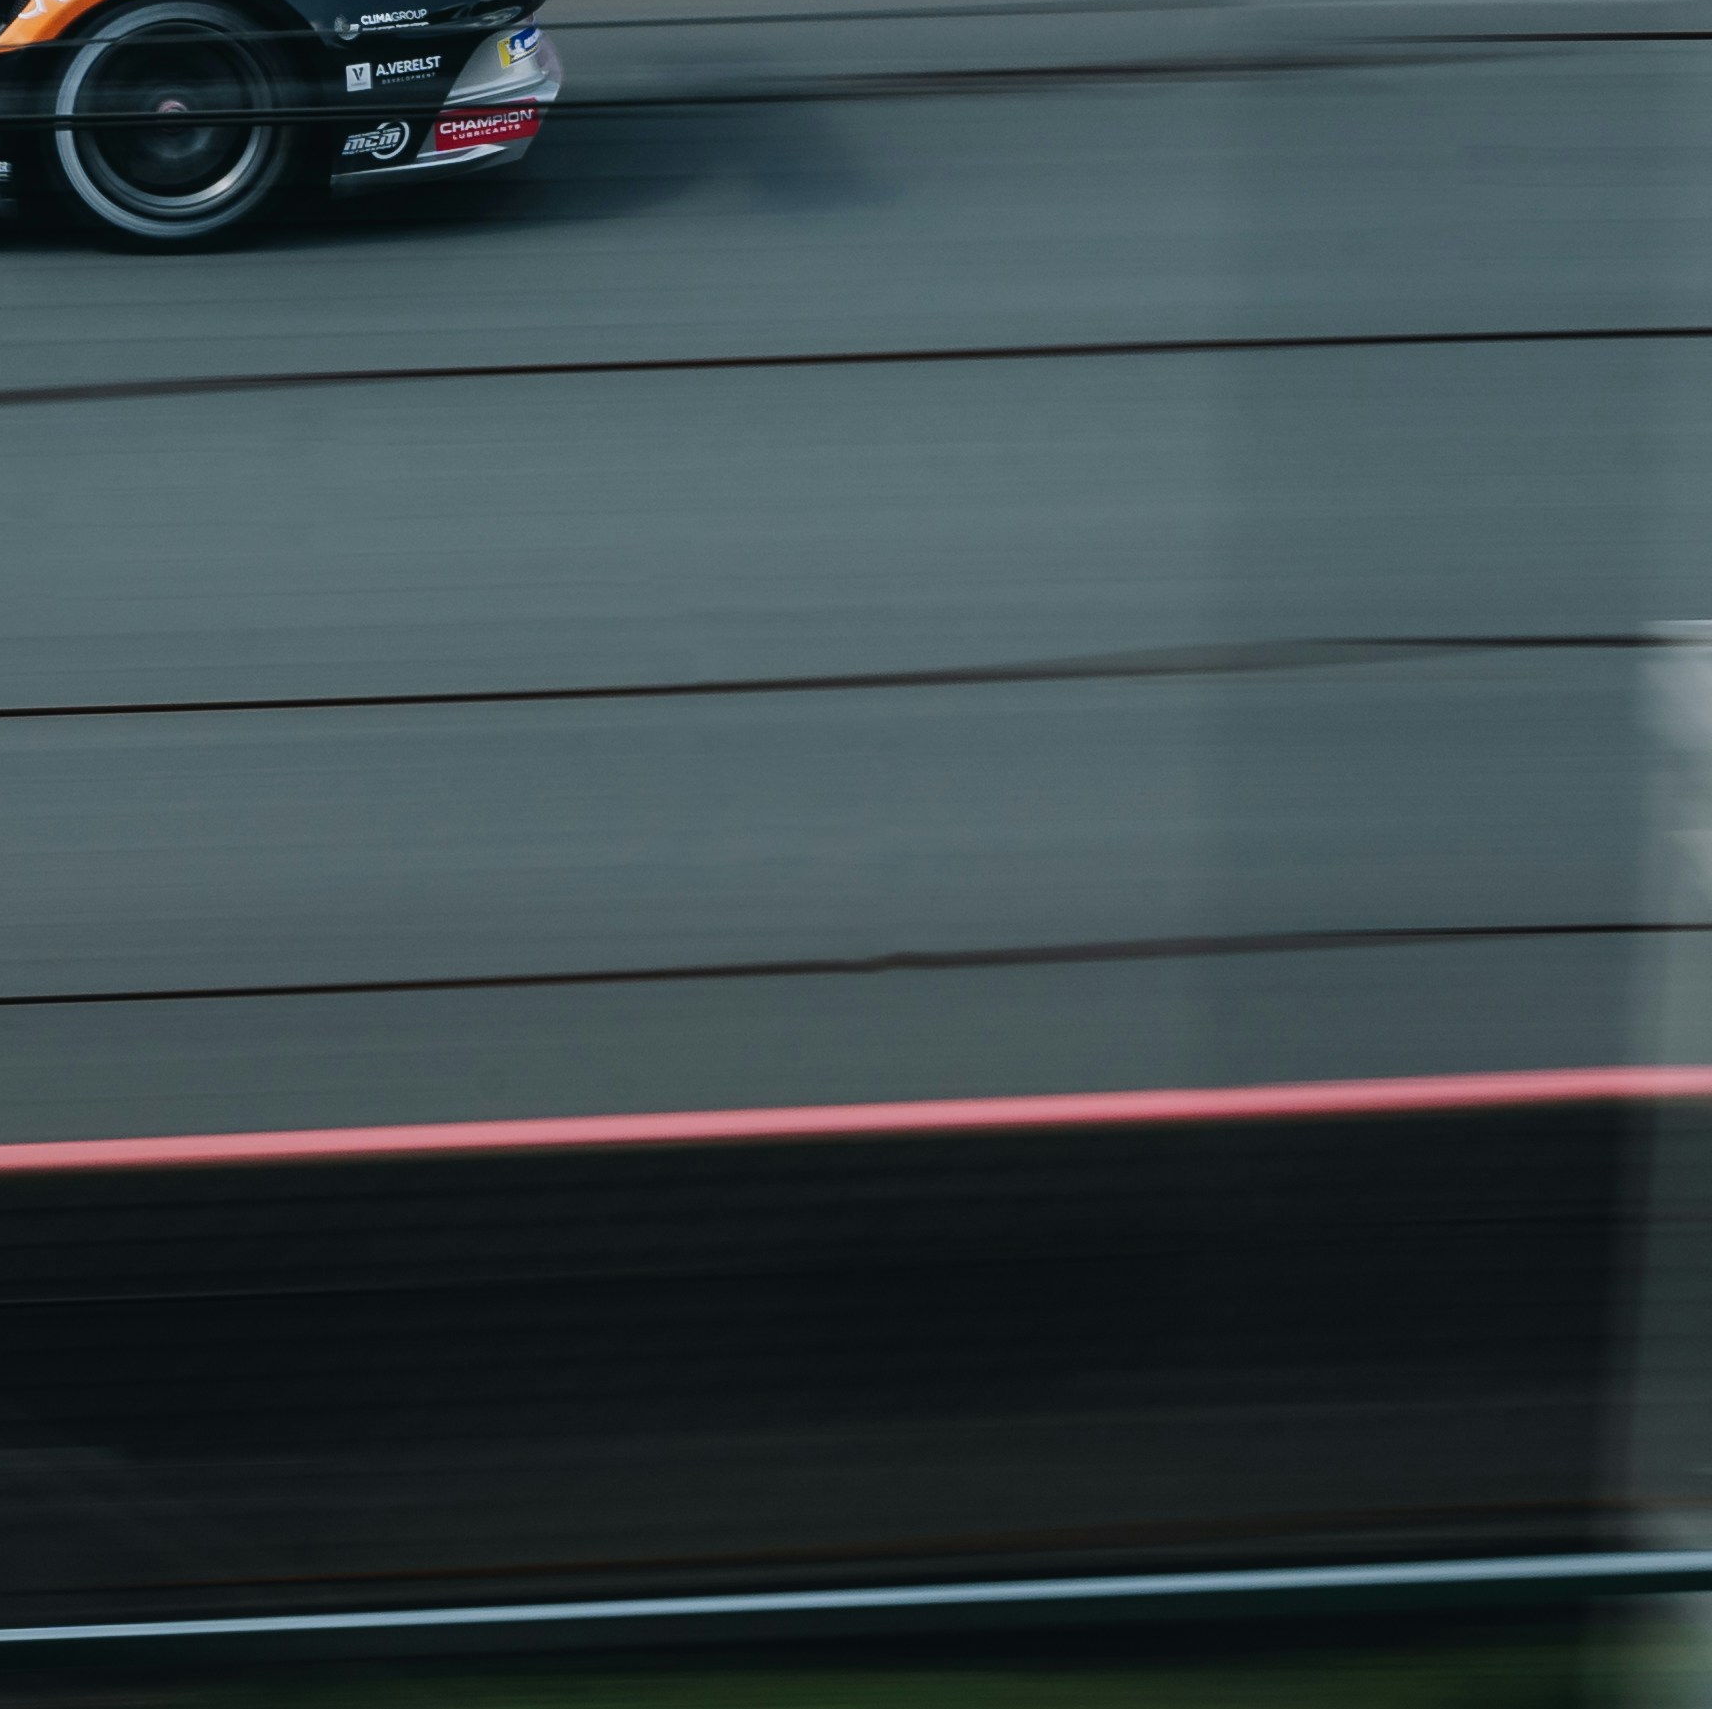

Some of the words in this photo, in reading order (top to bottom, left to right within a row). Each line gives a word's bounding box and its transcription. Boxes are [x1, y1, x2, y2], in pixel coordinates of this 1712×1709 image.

[361, 9, 428, 25] CLIMAGROUP
[376, 56, 441, 76] A.VERELST
[440, 109, 534, 134] CHAMPION
[453, 124, 521, 140] LUBRICANTS
